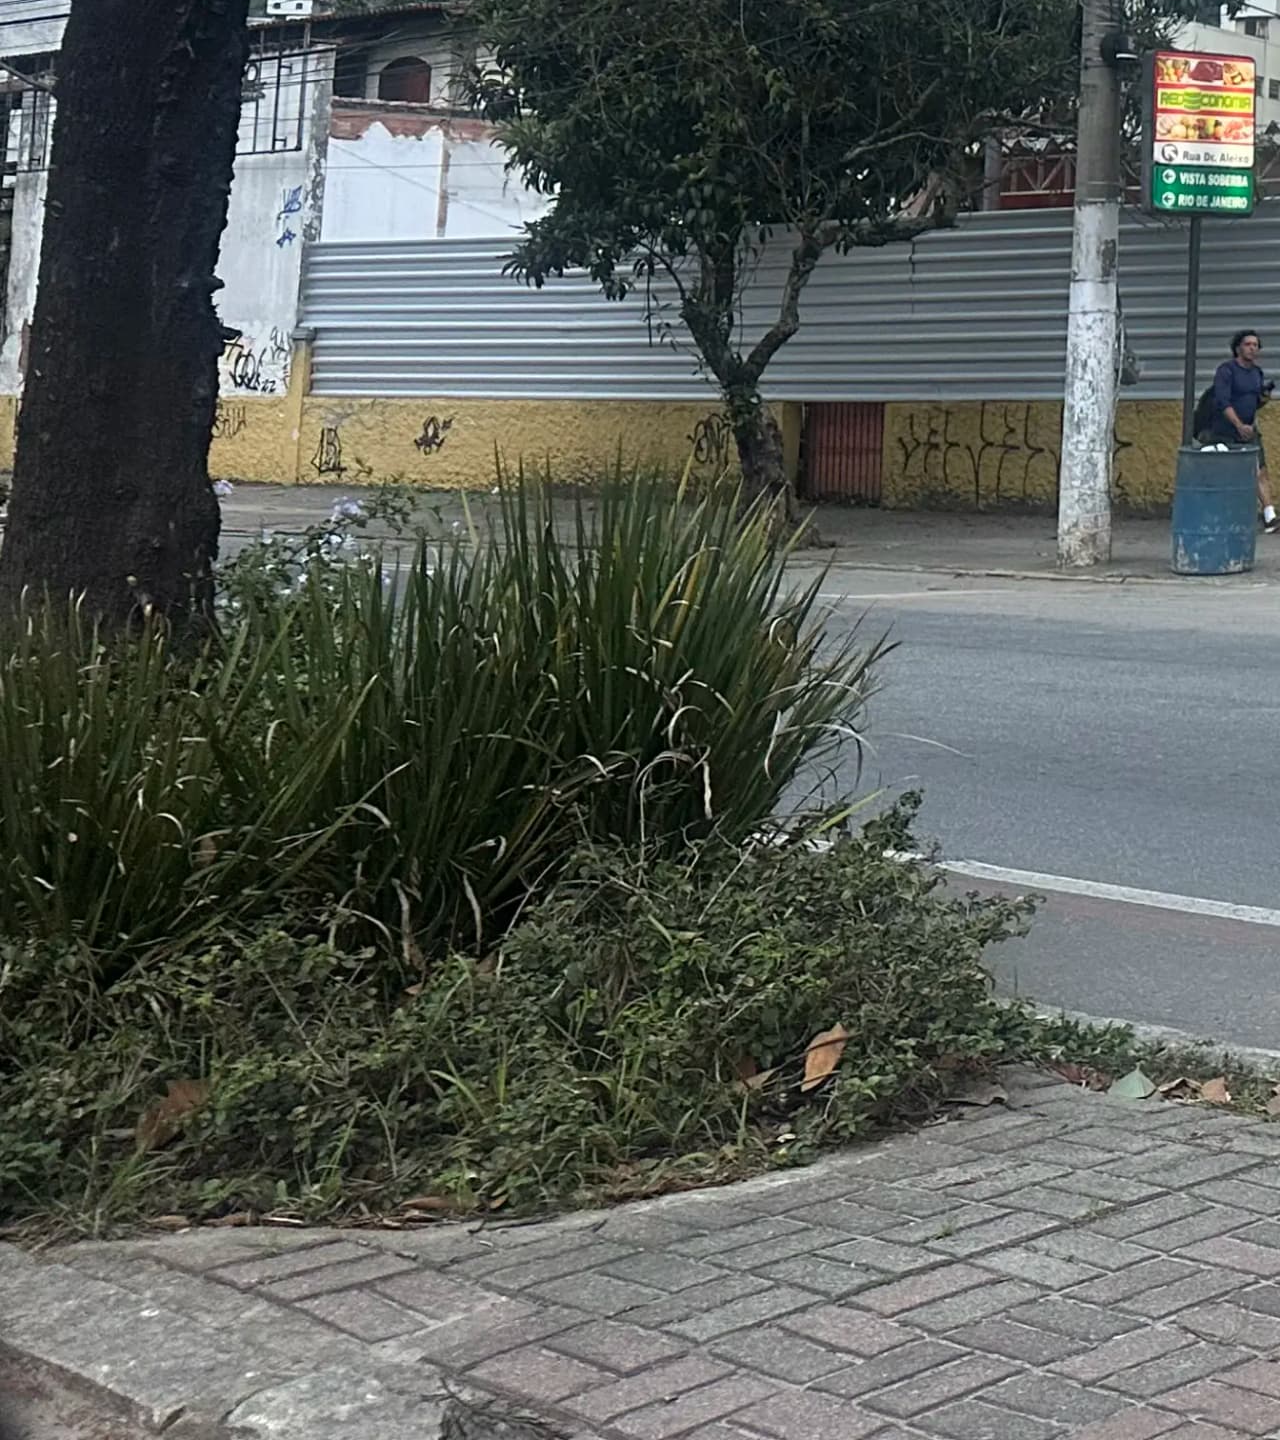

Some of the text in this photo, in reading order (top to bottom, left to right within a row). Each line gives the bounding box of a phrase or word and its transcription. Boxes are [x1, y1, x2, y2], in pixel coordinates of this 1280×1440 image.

[1183, 151, 1200, 161] Rua
[1179, 172, 1206, 185] VISTA
[1178, 194, 1248, 208] RIO DE JANEIRO
